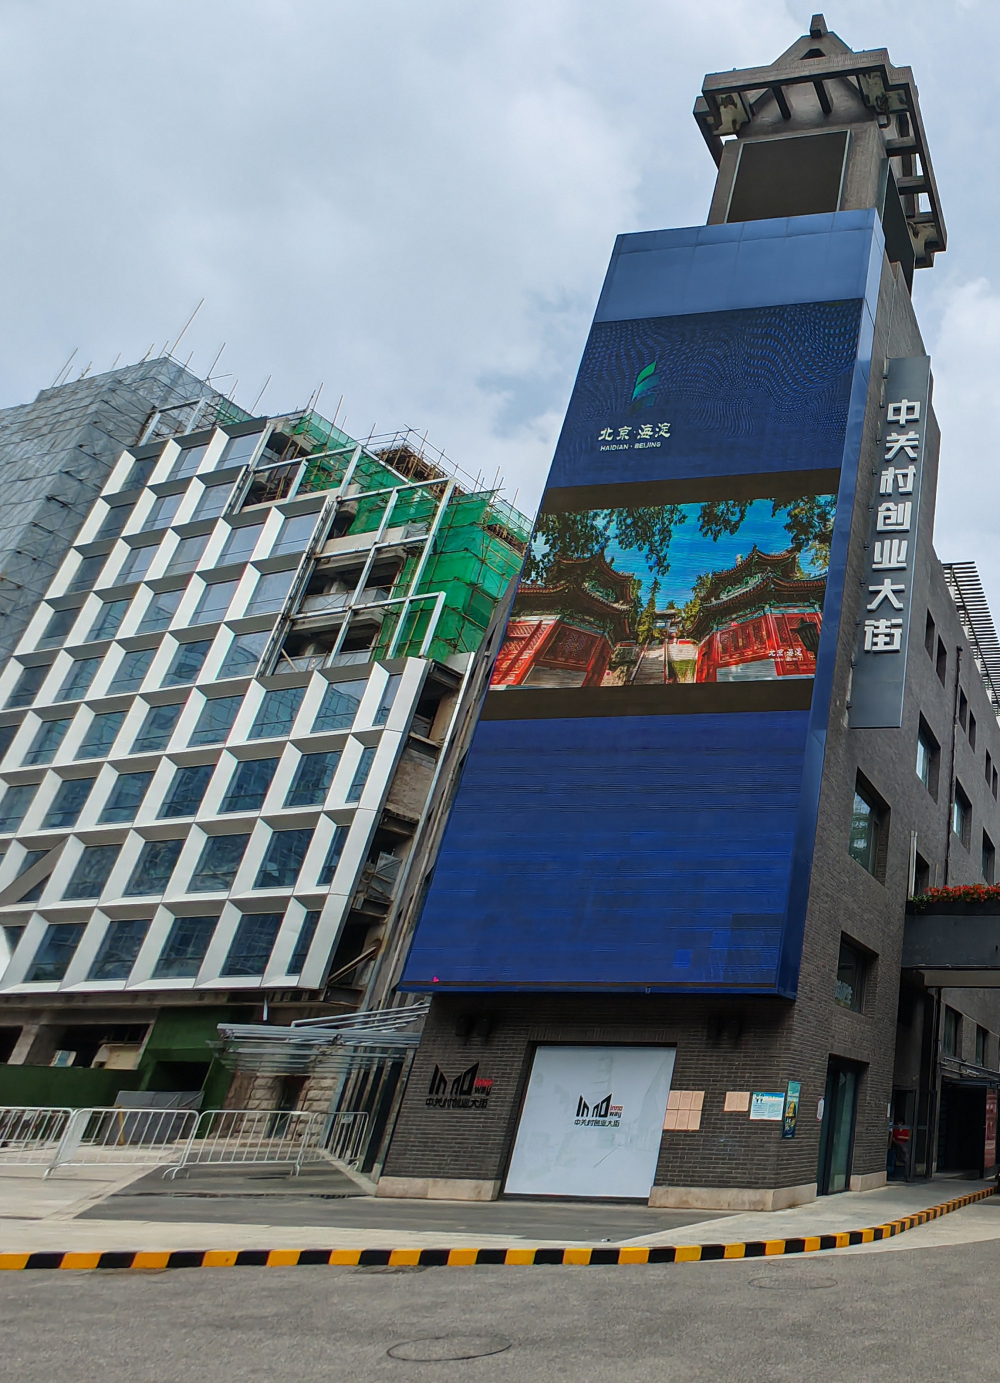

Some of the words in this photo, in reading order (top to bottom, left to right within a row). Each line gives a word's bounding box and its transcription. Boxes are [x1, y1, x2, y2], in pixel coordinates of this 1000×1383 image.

[600, 443, 629, 452] HAIDIAN
[634, 441, 661, 449] BEIJING
[864, 399, 921, 653] 中关村创业大街
[574, 1119, 620, 1127] 中关村创业大街
